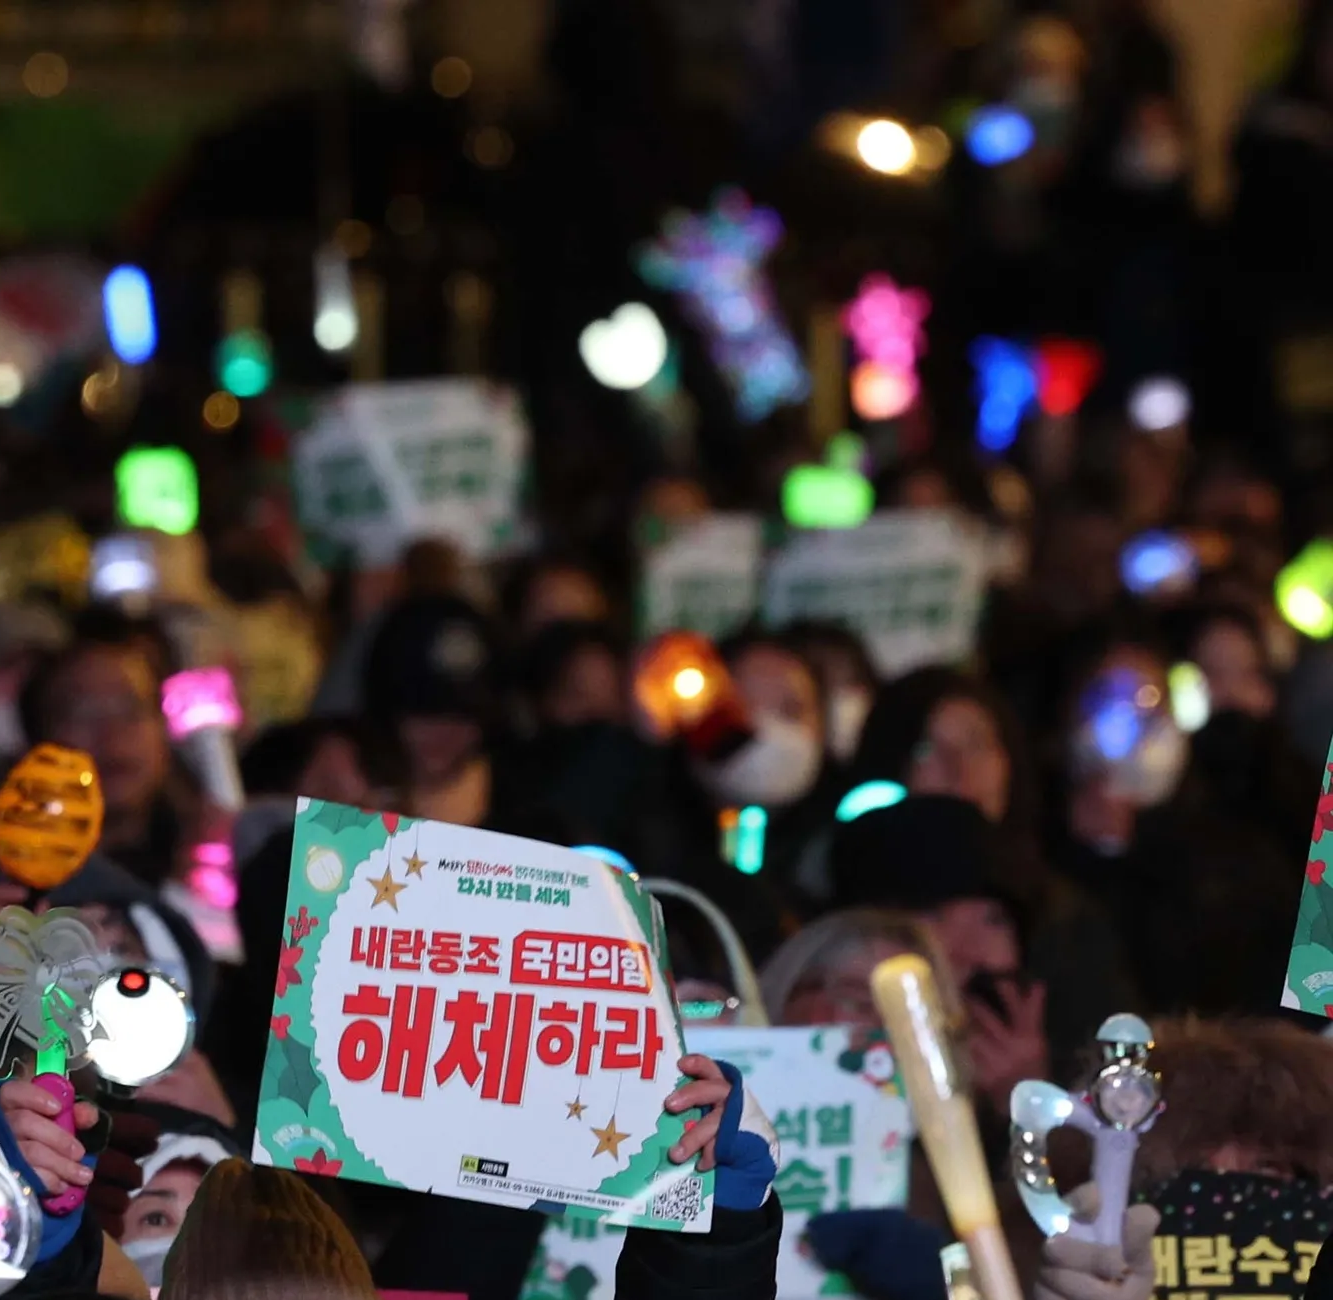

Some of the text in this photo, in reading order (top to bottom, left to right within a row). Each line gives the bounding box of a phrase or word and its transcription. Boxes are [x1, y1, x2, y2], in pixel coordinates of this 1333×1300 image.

[350, 925, 650, 989] 내란동조 국민의힘
[337, 984, 664, 1107] 해체하라
